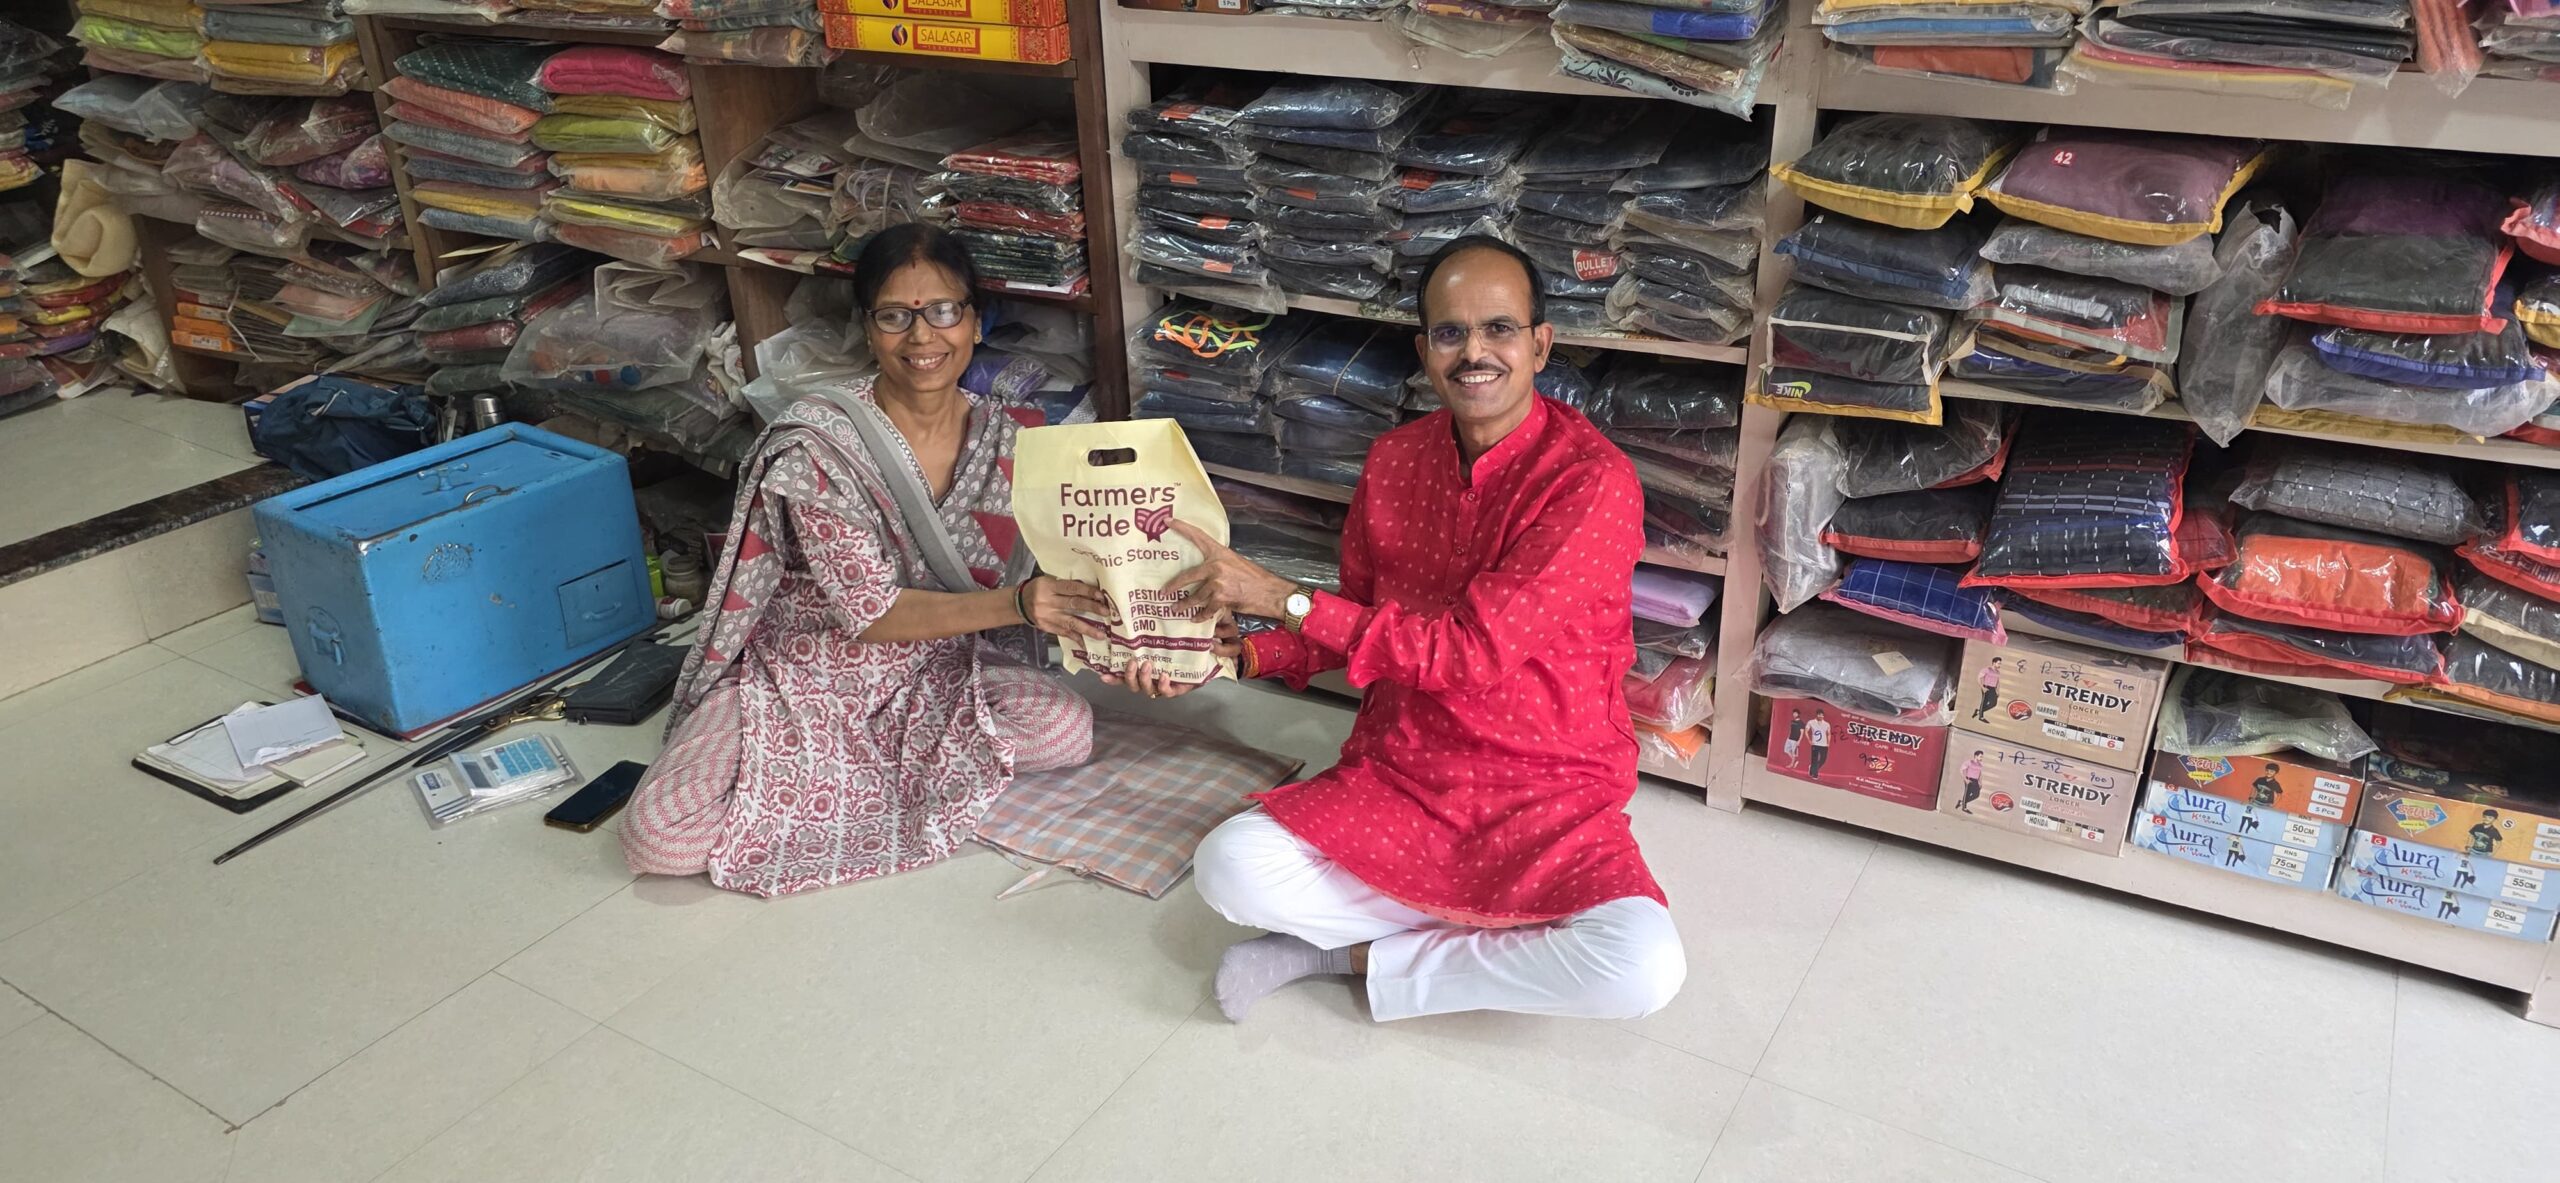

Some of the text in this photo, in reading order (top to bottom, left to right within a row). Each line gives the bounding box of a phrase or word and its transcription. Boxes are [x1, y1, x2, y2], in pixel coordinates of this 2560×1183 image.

[920, 28, 972, 45] SALASAR
[2054, 151, 2073, 165] 42
[1576, 257, 1614, 272] BULLET
[1775, 385, 1805, 398] NIKE
[1060, 483, 1176, 507] Farmers
[1062, 513, 1130, 537] Pride
[1126, 548, 1180, 562] Stores
[1133, 619, 1156, 632] GMO
[2042, 681, 2132, 713] STRENDY
[1848, 723, 1924, 749] STRENDY
[2107, 740, 2116, 748] 6
[2024, 774, 2111, 806] STRENDY
[2324, 781, 2341, 790] RNS
[2049, 795, 2080, 807] LONGER
[2168, 789, 2230, 823] Aura
[2292, 824, 2314, 835] 50CM
[2503, 820, 2513, 828] S
[2087, 832, 2096, 840] 6
[2156, 823, 2218, 856] Aura
[2275, 858, 2297, 869] 75CM
[2375, 843, 2444, 878] Aura
[2512, 878, 2537, 889] 55CM
[2493, 909, 2516, 921] 60CM
